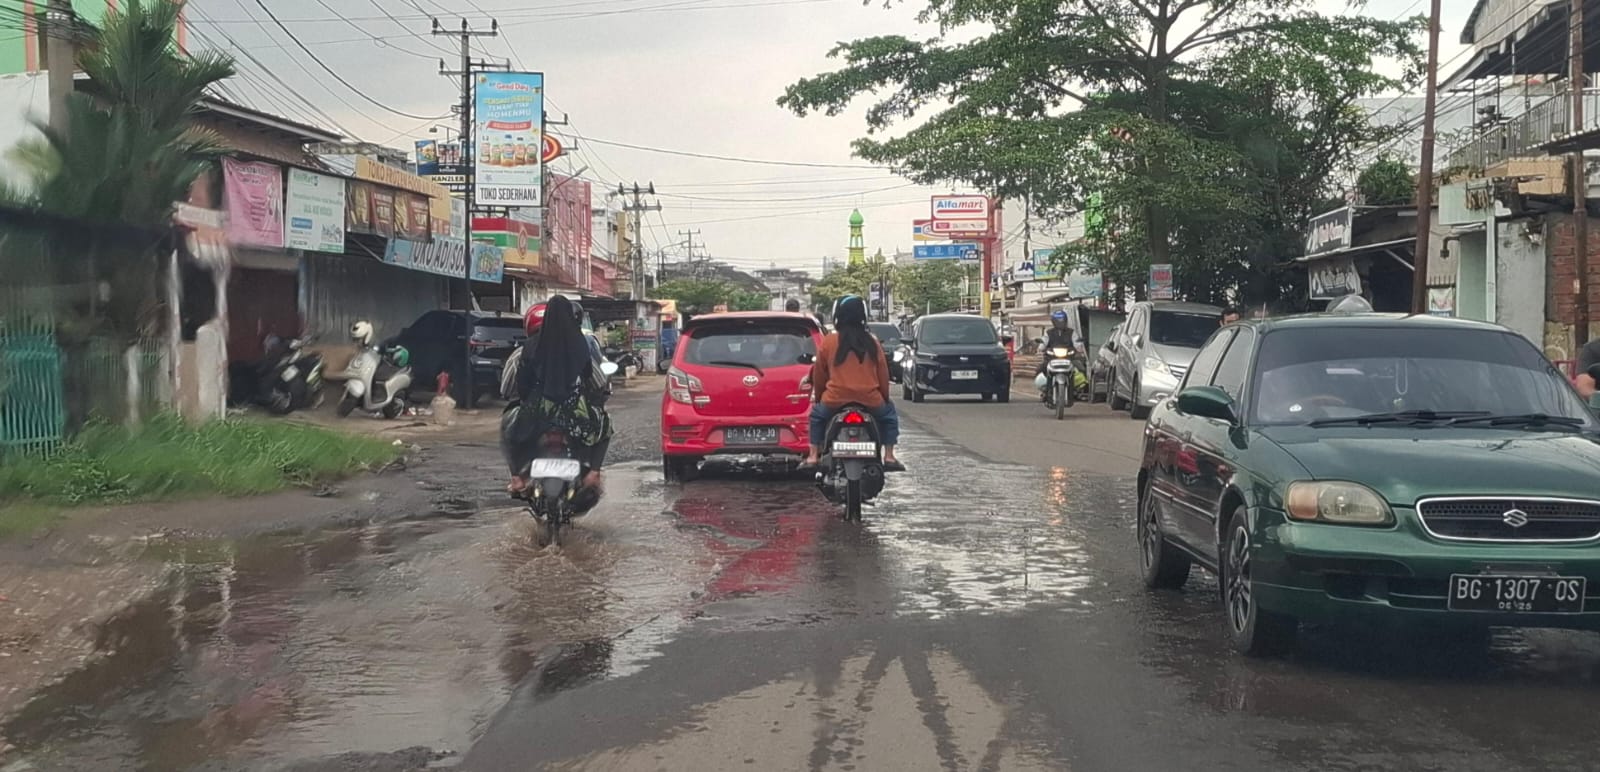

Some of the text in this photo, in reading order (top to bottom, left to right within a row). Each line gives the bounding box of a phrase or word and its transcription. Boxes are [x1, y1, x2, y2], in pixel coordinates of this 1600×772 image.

[515, 83, 529, 91] Day
[368, 160, 385, 181] TOKO
[480, 187, 498, 200] TOKO
[498, 188, 537, 201] SEDERHANA
[936, 201, 984, 209] Alfamart
[1456, 578, 1579, 601] BG 1307 OS
